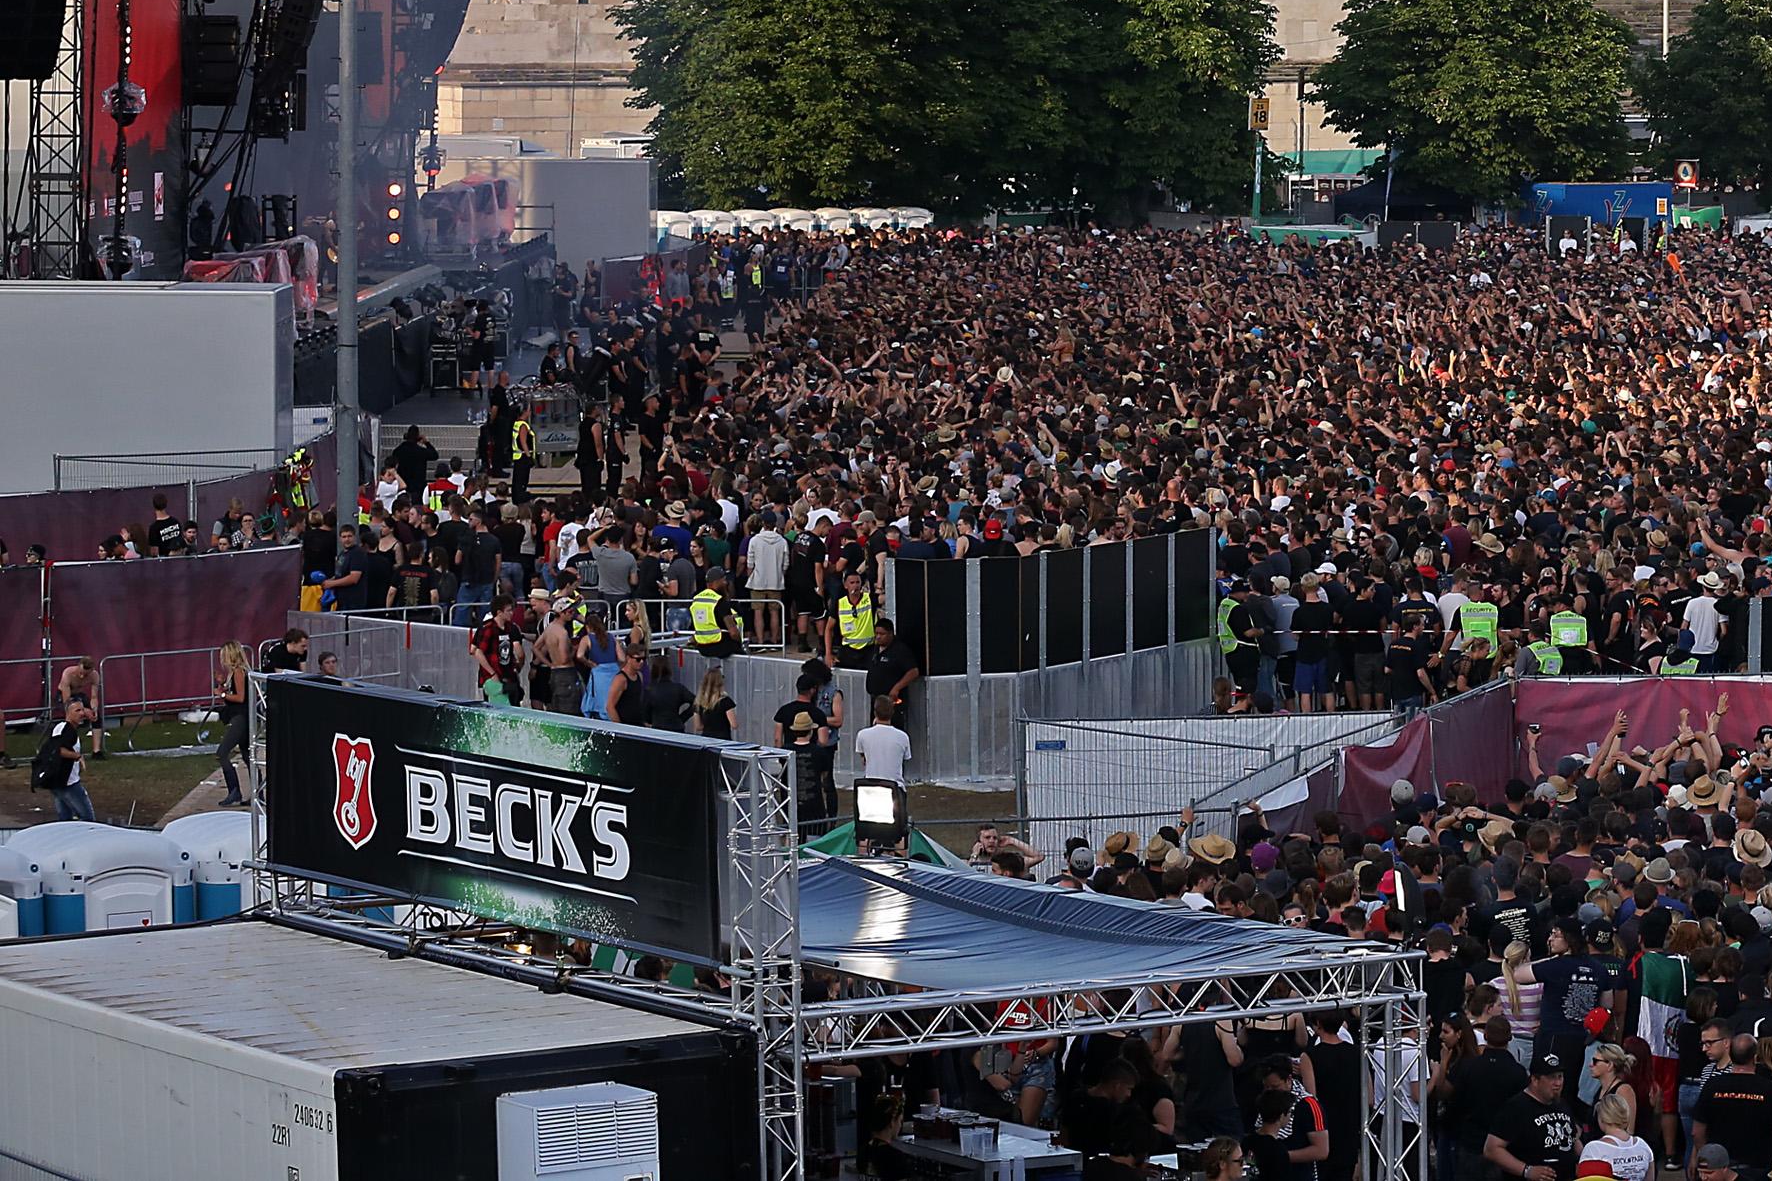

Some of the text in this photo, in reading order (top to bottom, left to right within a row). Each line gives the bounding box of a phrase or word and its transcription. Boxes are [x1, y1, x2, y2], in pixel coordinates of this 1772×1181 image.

[1253, 111, 1267, 124] 18
[404, 764, 631, 881] BECK'S
[295, 1104, 324, 1131] 240632
[271, 1123, 291, 1147] 22R1
